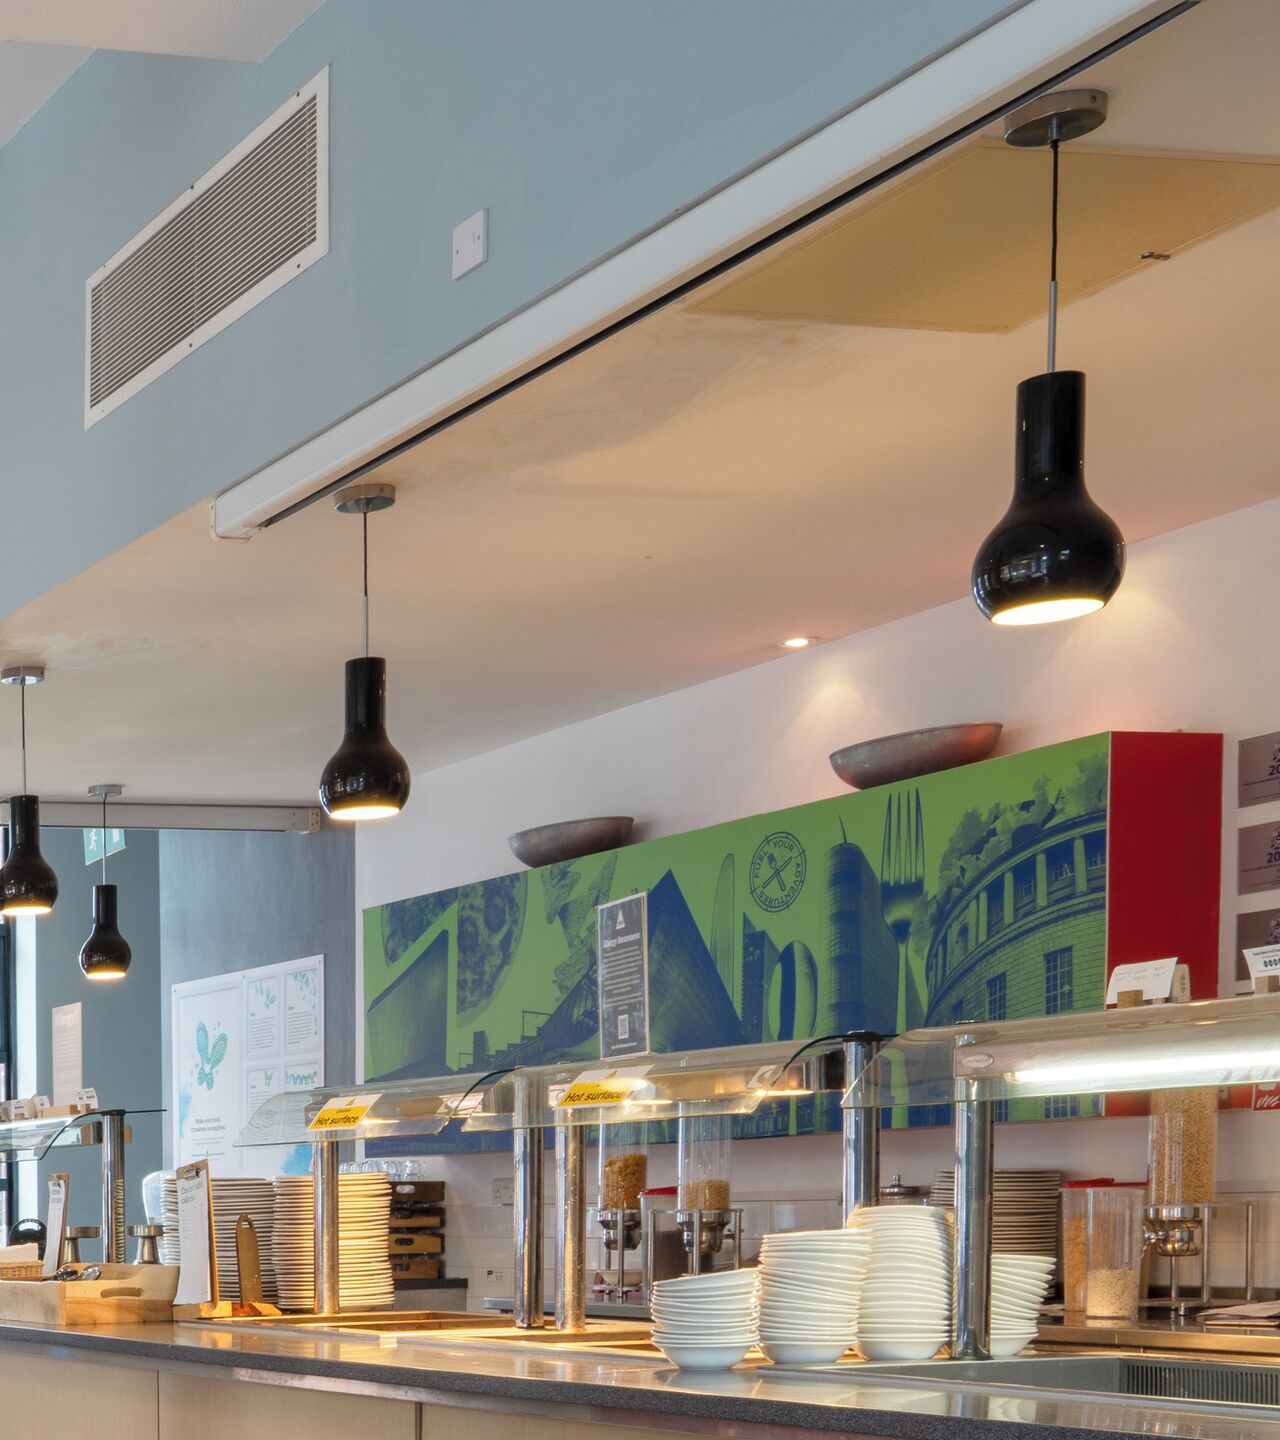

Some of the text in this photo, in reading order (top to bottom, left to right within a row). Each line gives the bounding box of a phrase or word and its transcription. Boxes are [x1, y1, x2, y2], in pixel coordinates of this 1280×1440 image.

[754, 839, 801, 906] FUEL YOUR ADVENTURES
[564, 1090, 622, 1103] Hot surface
[315, 1113, 359, 1127] Hot surface
